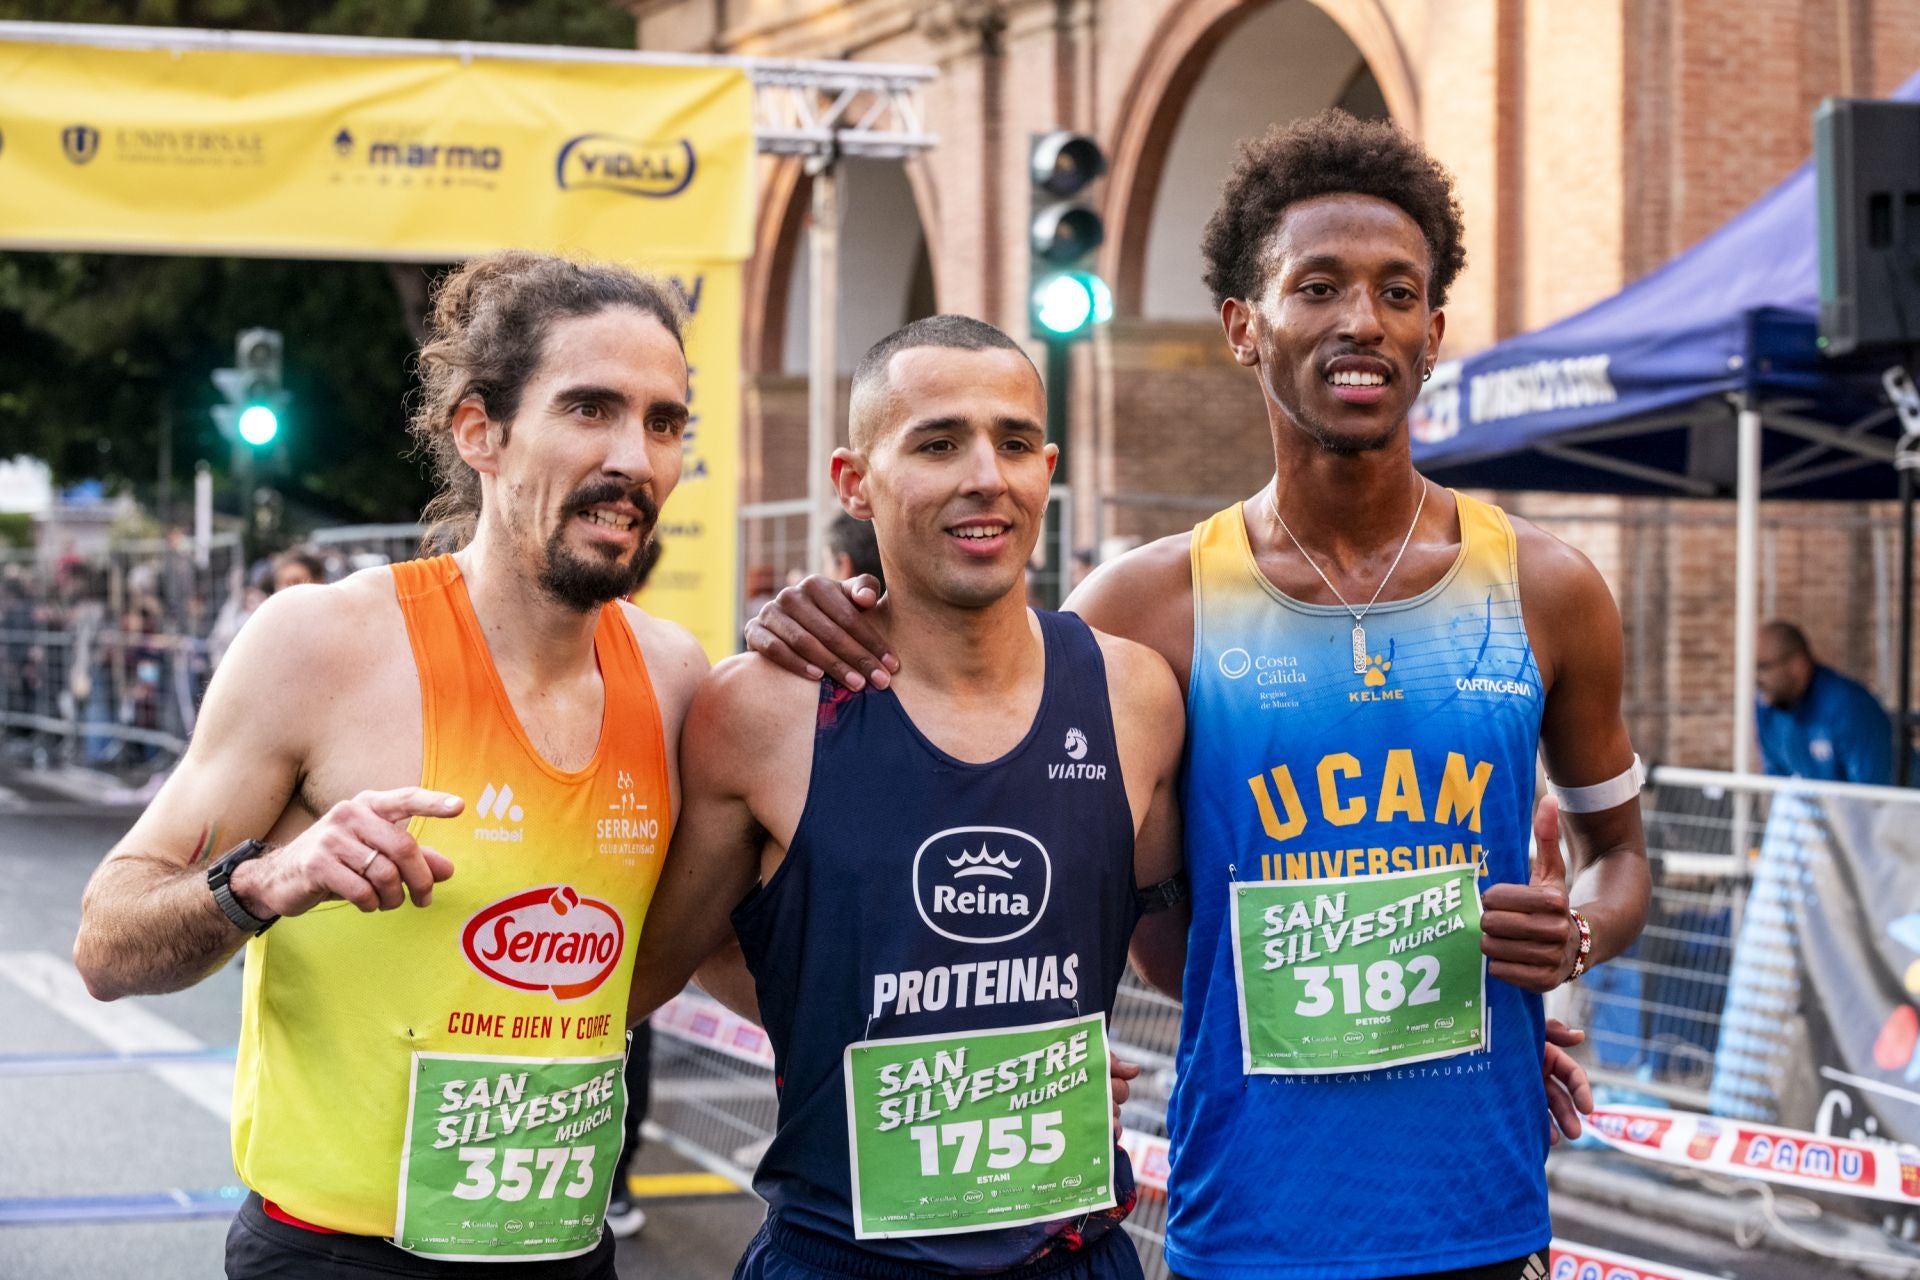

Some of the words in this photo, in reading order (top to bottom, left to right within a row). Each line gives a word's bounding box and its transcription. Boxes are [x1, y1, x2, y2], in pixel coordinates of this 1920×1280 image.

[369, 141, 501, 171] marmo
[579, 152, 676, 180] VIDAL
[1255, 655, 1297, 670] Costa
[1257, 669, 1307, 686] Cálida
[1260, 690, 1287, 700] Región
[1349, 689, 1404, 702] KELME
[1456, 678, 1531, 697] CARTAGENA
[1261, 701, 1271, 710] de
[1272, 699, 1299, 709] Murcia
[1048, 763, 1107, 780] VIATOR
[1248, 749, 1494, 842] UCAM
[596, 819, 658, 839] SERRANO
[599, 844, 617, 854] CLUB
[619, 844, 655, 855] ATLETISMO
[1261, 843, 1489, 881] UNIVERSIDAD
[933, 884, 1030, 916] Reina
[1263, 891, 1348, 937] SAN
[482, 915, 614, 965] Serrano
[1262, 877, 1461, 971] SILVESTRE
[1388, 914, 1465, 956] MURCIA
[872, 953, 1079, 1018] PROTEINAS
[1293, 955, 1441, 1018] 3182
[1465, 1000, 1473, 1008] M
[448, 1011, 506, 1038] COME
[511, 1016, 552, 1039] BIEN
[561, 1017, 571, 1039] Y
[576, 1014, 611, 1040] CORRE
[1355, 1016, 1391, 1026] PETROS
[878, 1046, 968, 1097] SAN
[878, 1030, 1088, 1132] SILVESTRE
[1270, 1074, 1372, 1085] AMERICAN
[1386, 1061, 1492, 1081] RESTAURANT
[437, 1072, 530, 1114] SAN
[1009, 1067, 1088, 1111] MURCIA
[433, 1068, 616, 1149] SILVESTRE
[555, 1105, 612, 1143] MURCIA
[910, 1110, 1066, 1177] 1755
[1748, 1135, 1863, 1180] FAMU
[452, 1145, 596, 1202] 3573
[1093, 1157, 1100, 1165] M
[976, 1173, 1010, 1184] ESTANI
